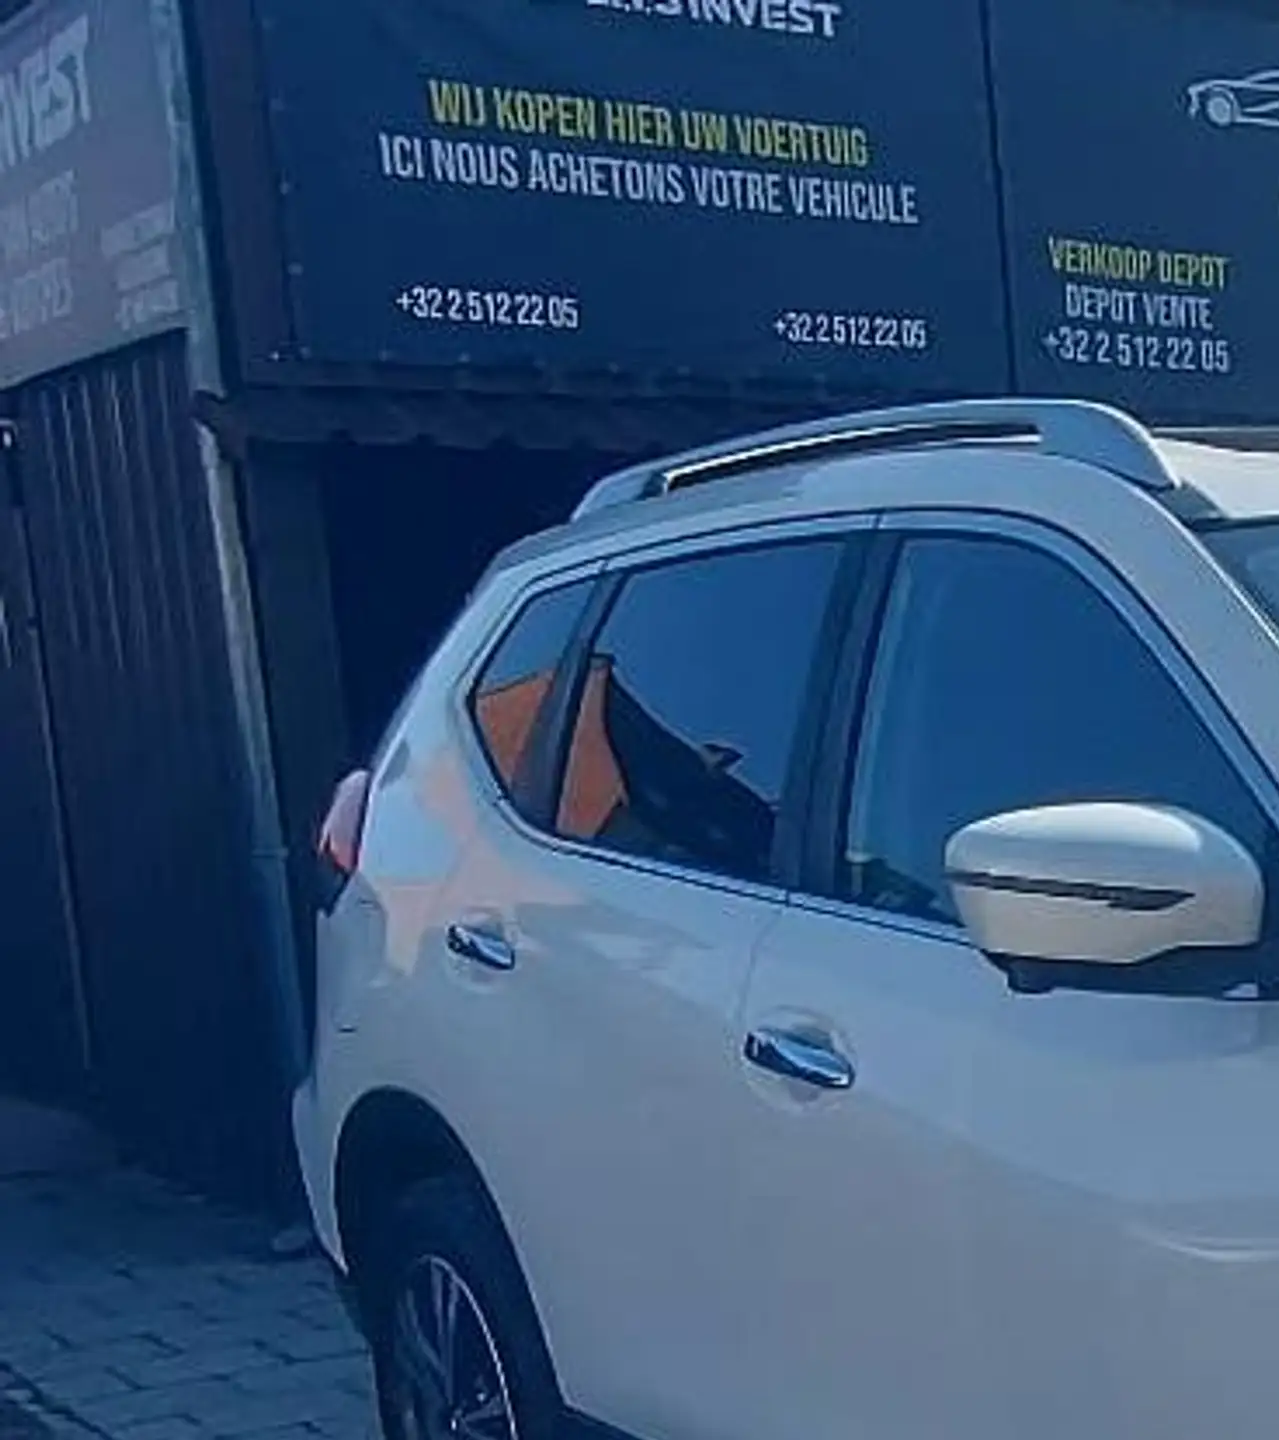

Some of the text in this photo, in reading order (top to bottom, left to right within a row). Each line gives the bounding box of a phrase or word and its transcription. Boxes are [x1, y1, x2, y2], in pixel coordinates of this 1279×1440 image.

[428, 79, 868, 168] WIJ KOPEN HIER UW VOERTUIG
[378, 131, 919, 224] ICI NOUS ACHETONS VOTRE VEHICULE
[1048, 235, 1229, 290] VERKOOP DEPOT
[1065, 282, 1213, 330] DEPOT VENTE
[1043, 326, 1090, 362] +32
[1117, 333, 1162, 367] 512
[1166, 337, 1196, 369] 22
[1200, 339, 1229, 372] 05
